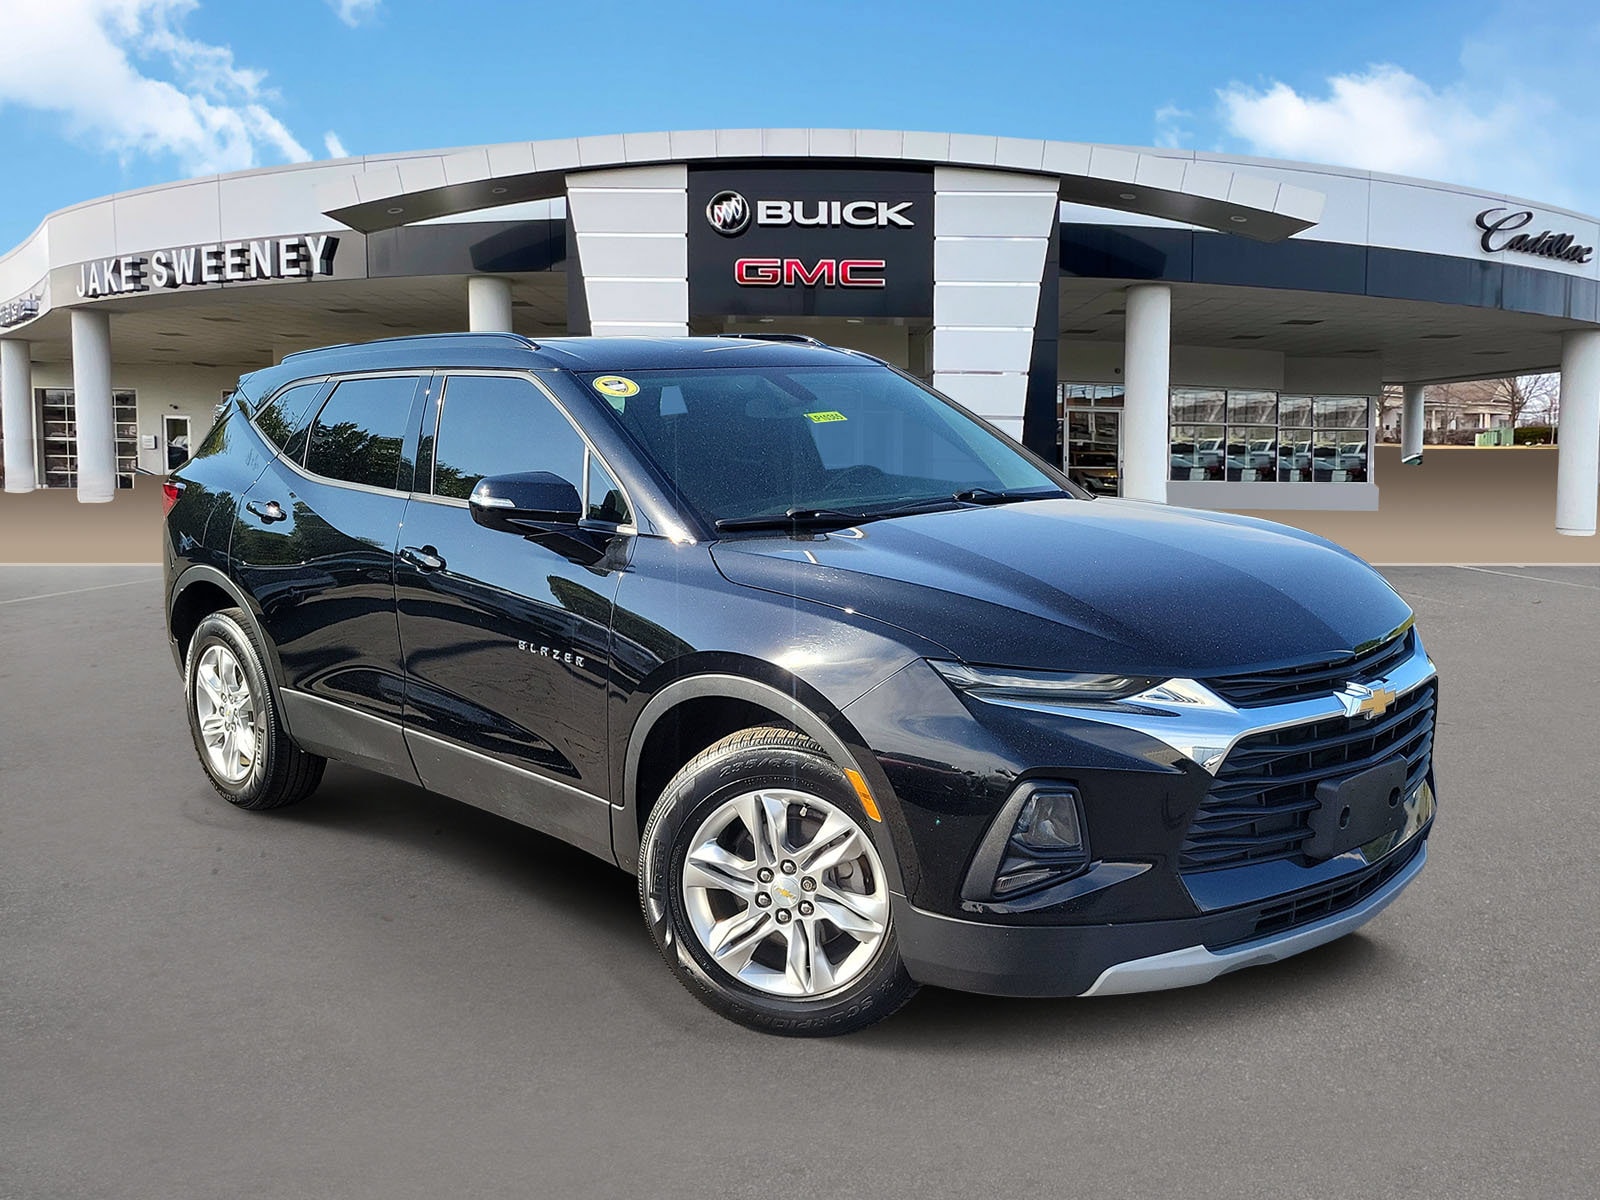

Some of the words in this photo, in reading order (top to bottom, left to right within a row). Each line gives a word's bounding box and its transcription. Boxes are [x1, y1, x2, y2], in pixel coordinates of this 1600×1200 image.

[757, 200, 915, 227] BUICK
[1475, 207, 1593, 264] Cadillac
[76, 256, 148, 299] JAKE
[152, 235, 338, 287] SWEENEY
[735, 258, 886, 287] GMC
[518, 640, 585, 667] BLAZER
